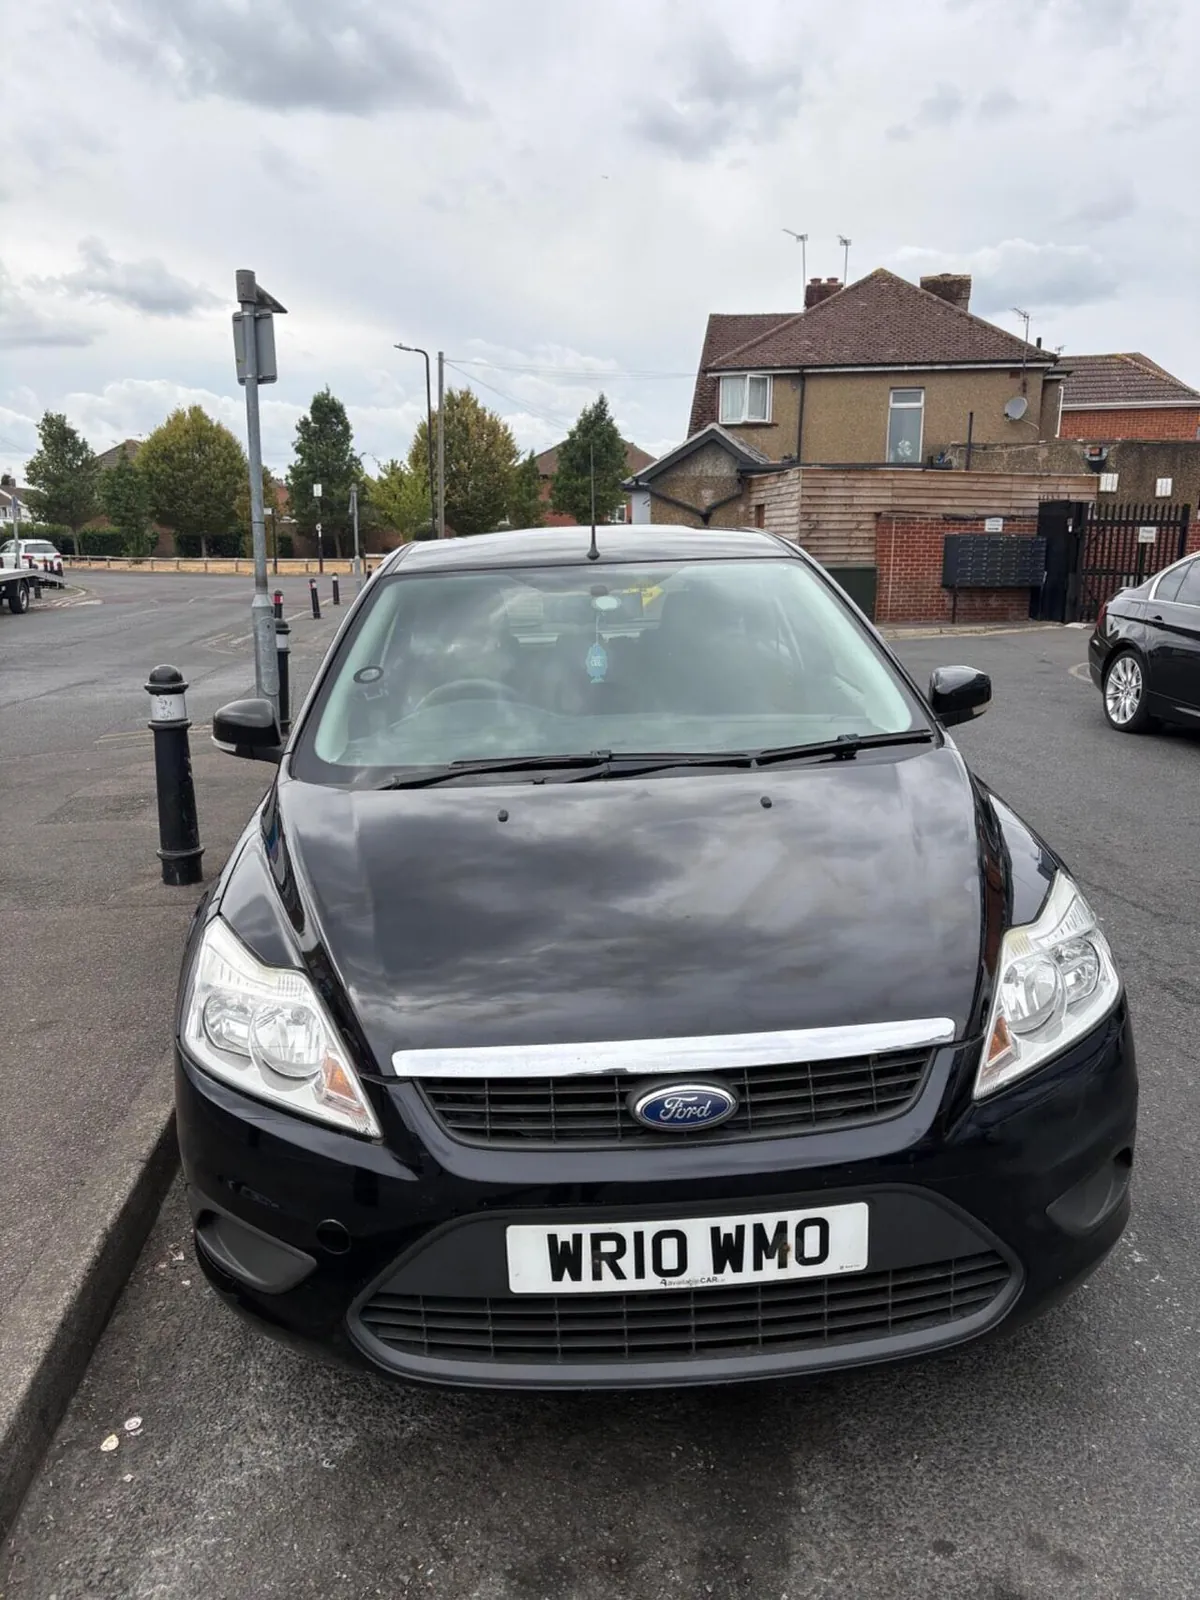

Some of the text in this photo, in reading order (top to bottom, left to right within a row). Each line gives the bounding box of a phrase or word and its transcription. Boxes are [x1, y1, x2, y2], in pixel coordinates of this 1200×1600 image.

[659, 1096, 711, 1121] Ford
[547, 1216, 830, 1282] WR10 WMO
